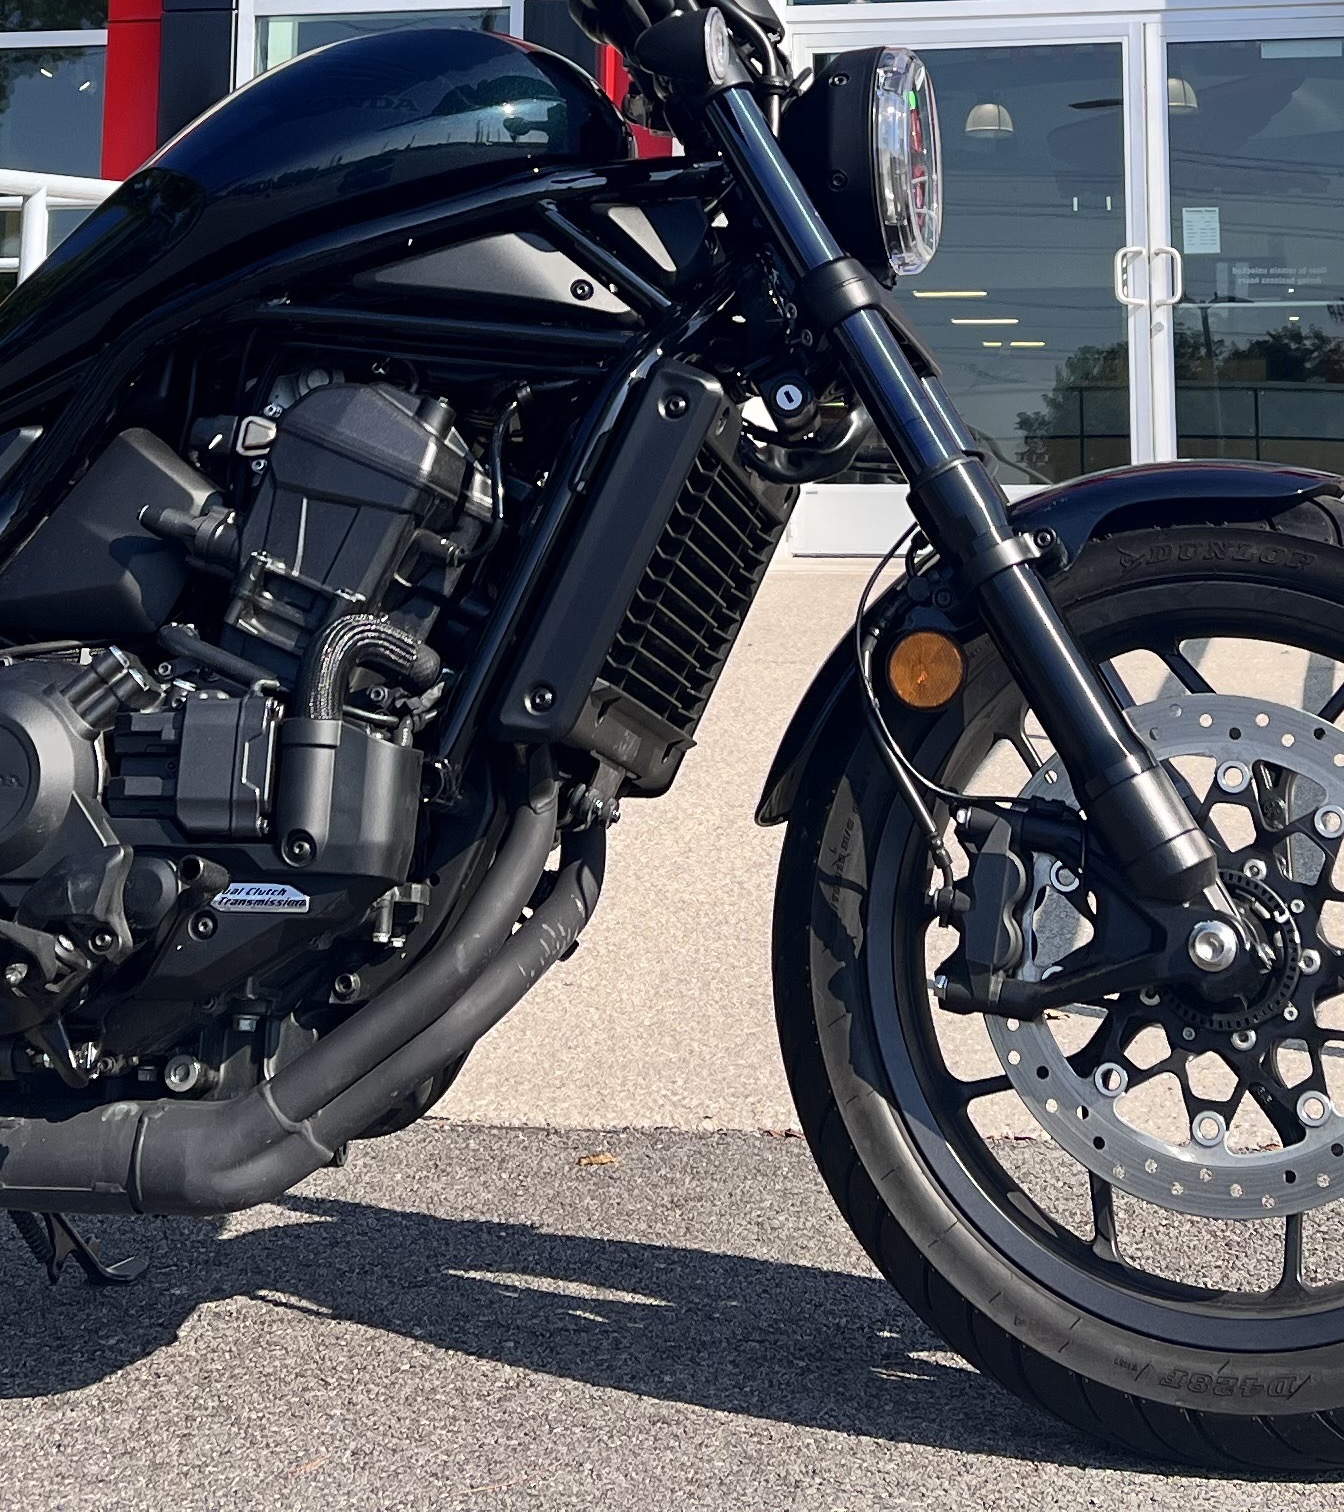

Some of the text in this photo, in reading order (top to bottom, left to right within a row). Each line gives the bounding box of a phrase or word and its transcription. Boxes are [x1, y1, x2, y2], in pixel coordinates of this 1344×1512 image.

[1145, 540, 1317, 571] DUNLOP
[218, 896, 307, 908] Transmission
[222, 887, 288, 897] ual Clutch
[1157, 1369, 1299, 1399] D428F
